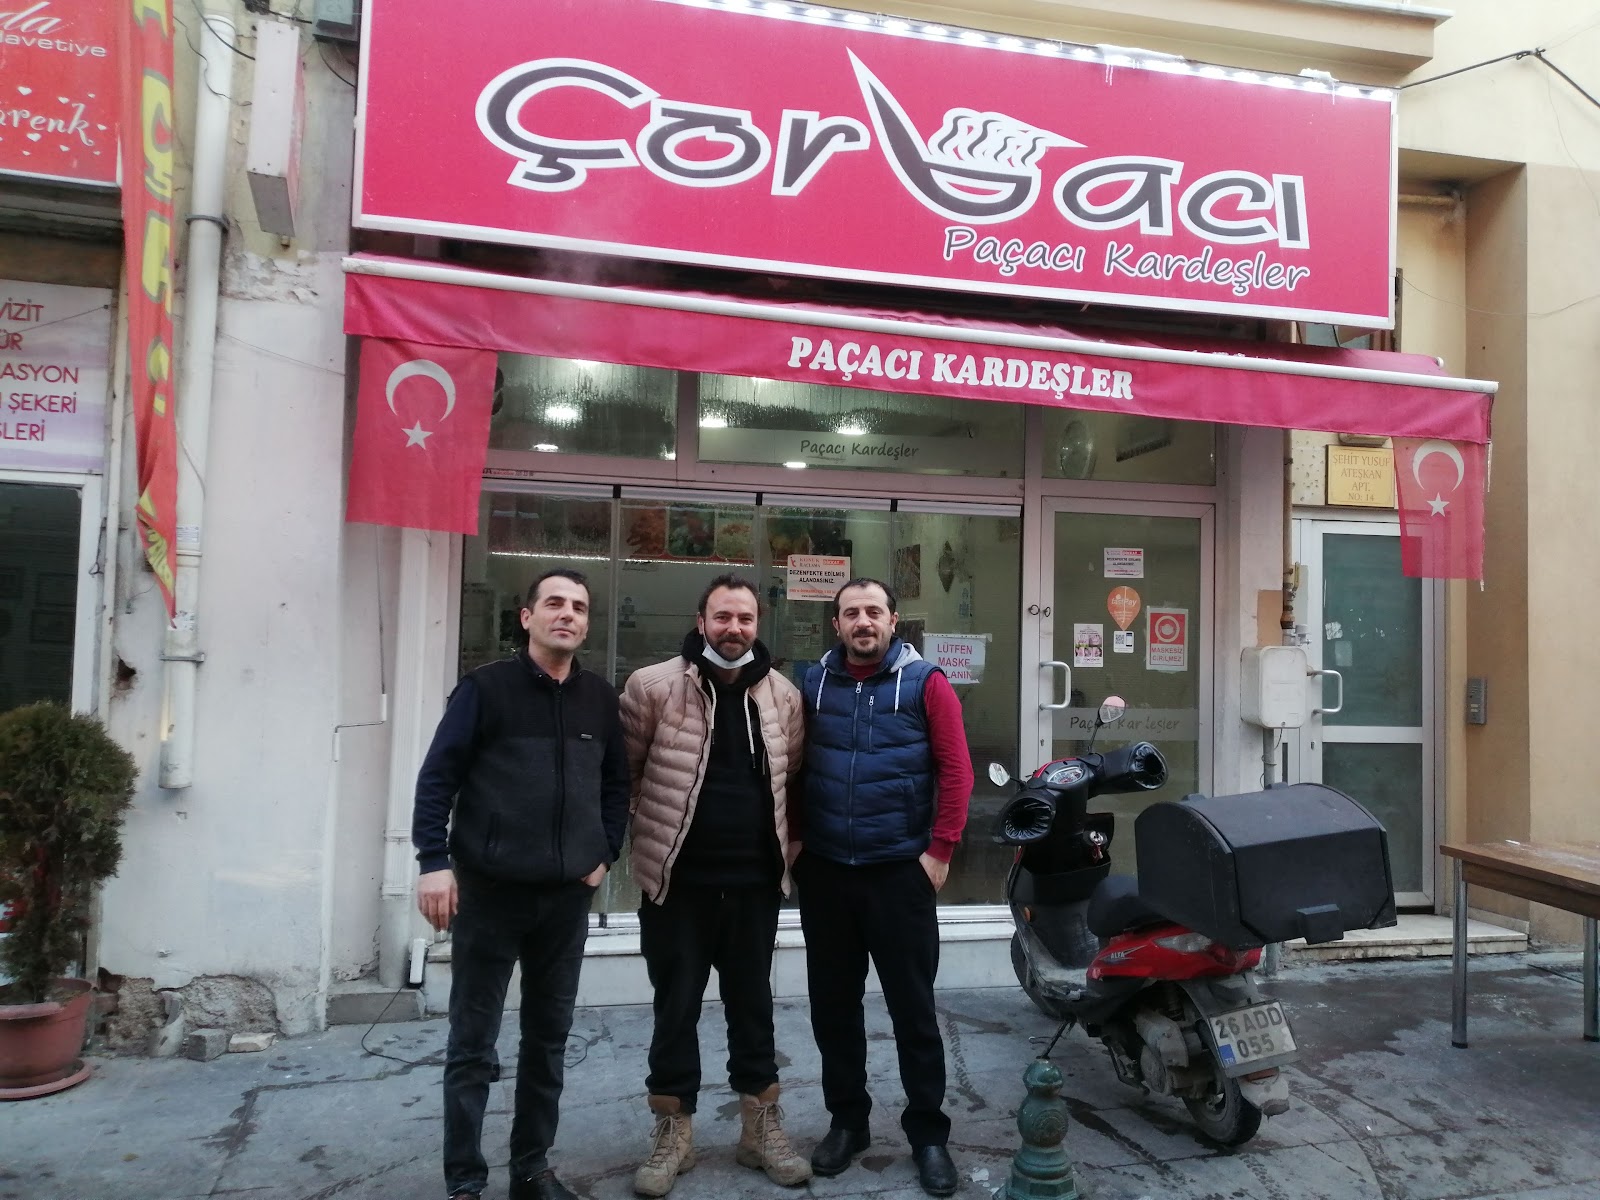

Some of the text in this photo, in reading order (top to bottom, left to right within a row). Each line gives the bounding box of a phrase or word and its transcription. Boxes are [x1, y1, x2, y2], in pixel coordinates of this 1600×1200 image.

[943, 225, 1310, 296] Paçacı Kardeşler
[0, 363, 78, 384] ASYON
[787, 336, 1134, 400] PAÇACI KARDEŞLER
[8, 391, 77, 414] ŞEKERİ
[0, 419, 45, 441] LERİ
[800, 440, 919, 460] Paçacı Kardeşler
[1361, 455, 1391, 467] YUSUF
[937, 642, 973, 655] LÜTFEN
[938, 657, 971, 668] MASKE
[1070, 716, 1112, 733] Paçcı
[1110, 952, 1126, 960] ALFA
[1215, 1006, 1283, 1039] 26 ADD
[1236, 1033, 1275, 1058] 055
